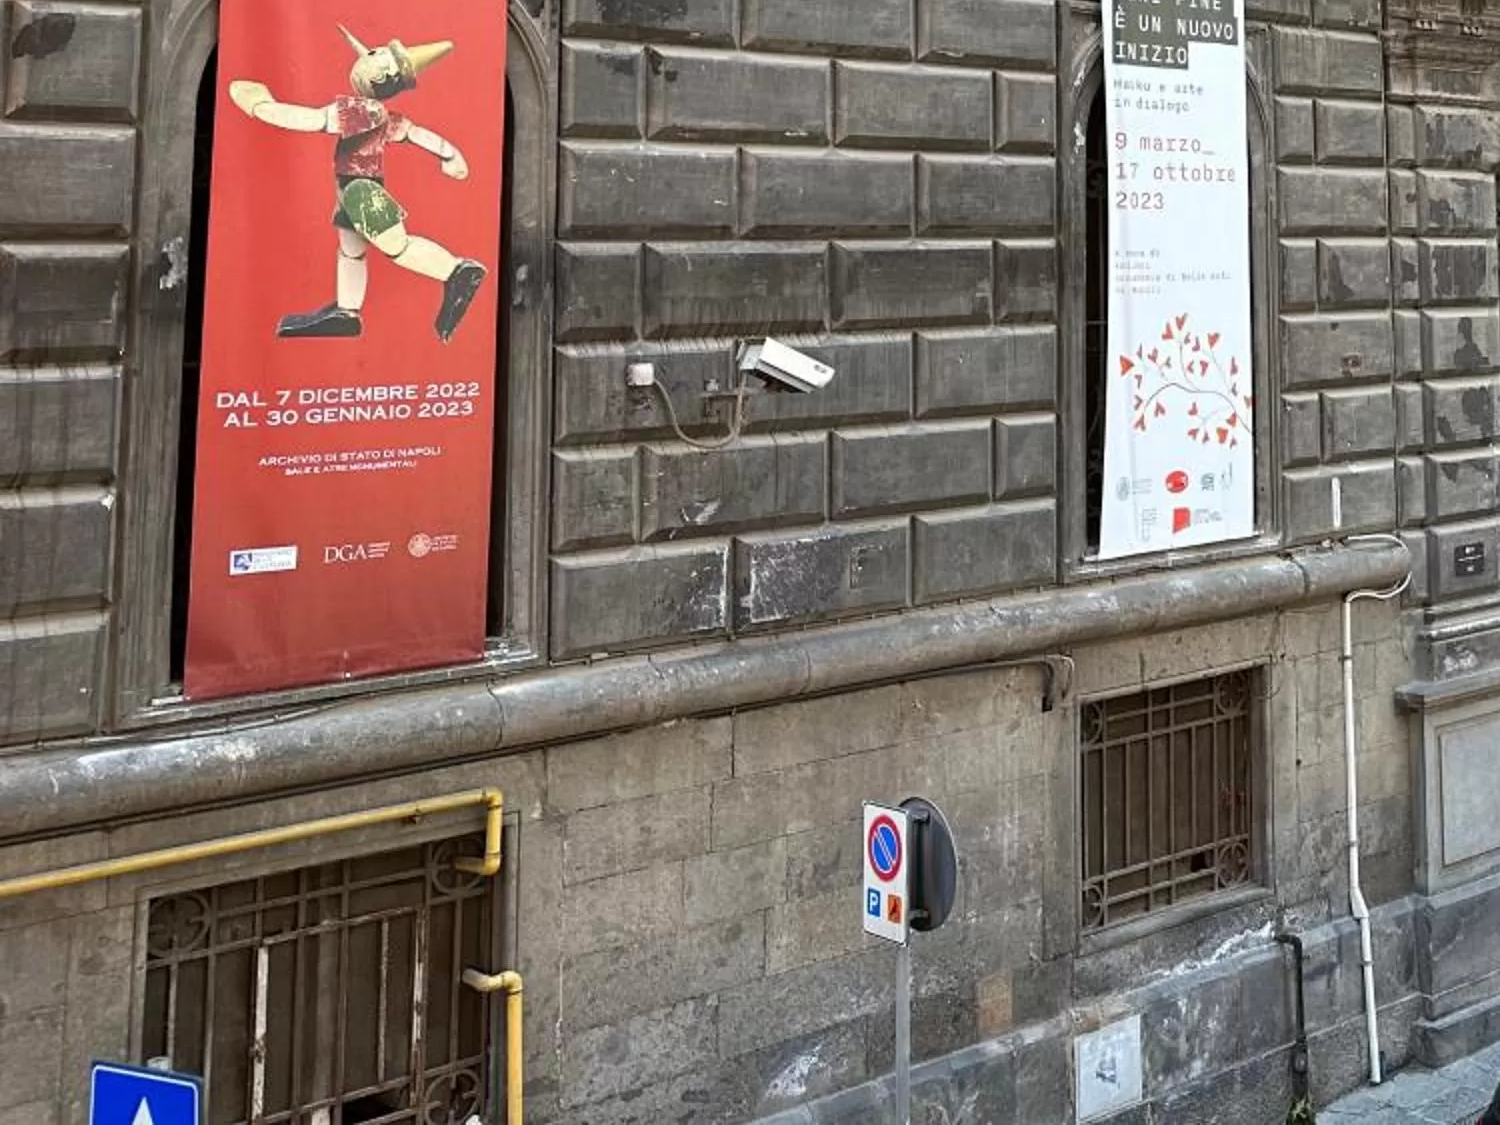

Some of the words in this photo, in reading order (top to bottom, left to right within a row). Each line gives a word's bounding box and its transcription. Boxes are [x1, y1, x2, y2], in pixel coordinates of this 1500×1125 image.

[1115, 5, 1126, 28] È
[1139, 15, 1162, 35] UN
[1176, 18, 1234, 41] NUOVO
[1115, 41, 1187, 65] INIZIO
[1115, 132, 1127, 150] 9
[1116, 162, 1139, 180] 17
[1153, 162, 1236, 183] ottobre
[1116, 191, 1165, 210] 2023
[216, 390, 266, 409] DAL
[276, 390, 291, 406] 7
[298, 384, 419, 405] DICEMBRE
[425, 381, 481, 399] 2022
[223, 411, 258, 428] AL
[266, 410, 299, 426] 30
[305, 404, 411, 424] GENNAIO
[417, 401, 474, 419] 2023
[259, 454, 322, 467] ARCHIVIO
[324, 454, 337, 463] DI
[339, 451, 381, 462] STATO
[383, 449, 395, 458] DI
[397, 446, 441, 458] NAPOLI
[323, 543, 368, 564] DGA
[869, 889, 880, 911] P
